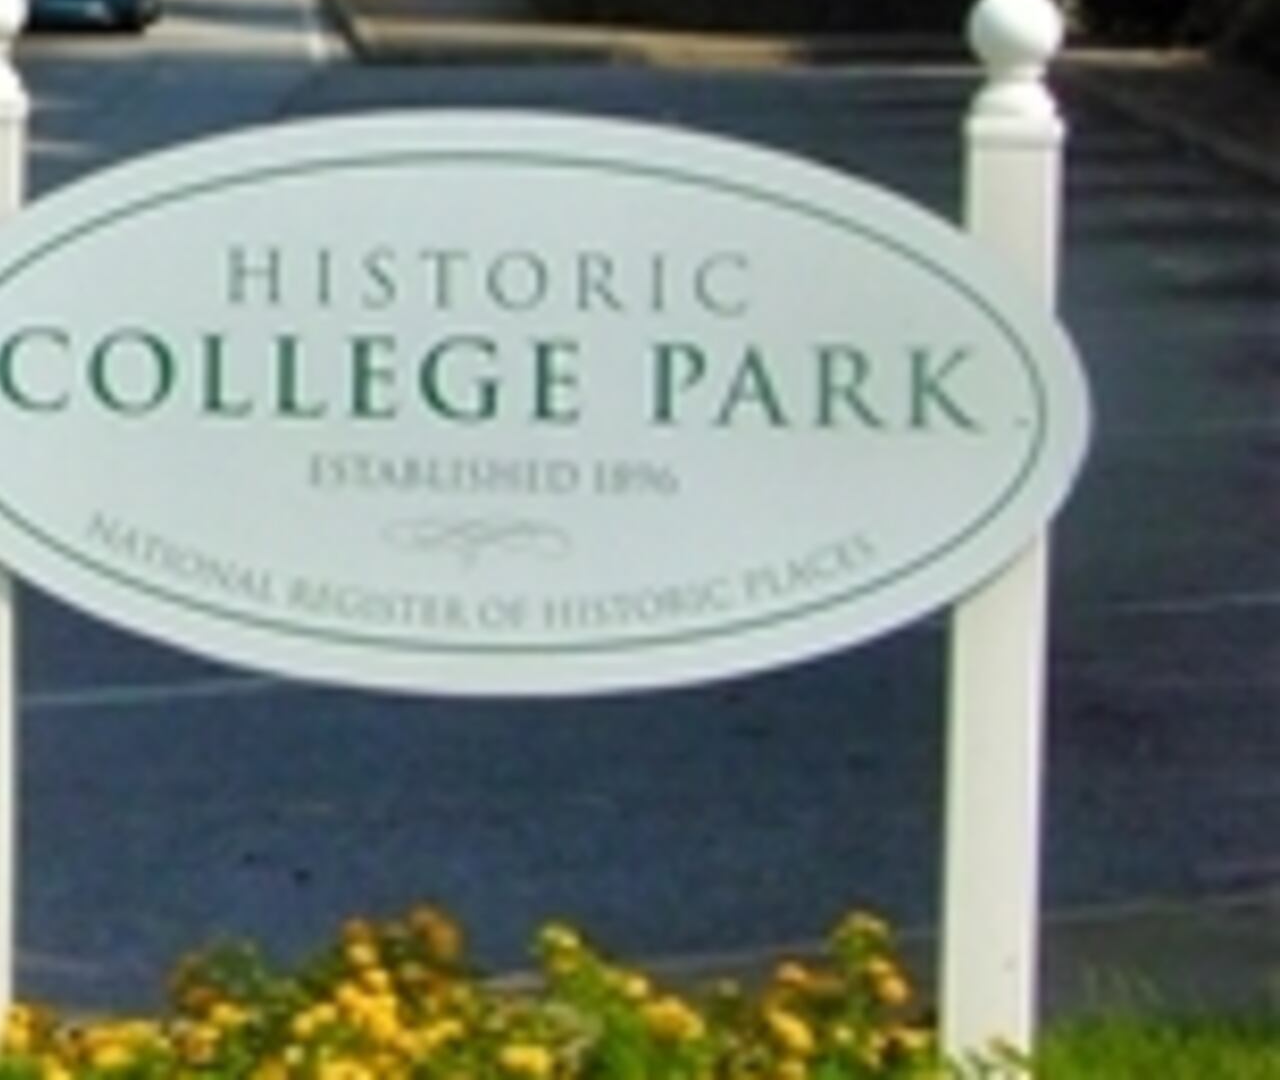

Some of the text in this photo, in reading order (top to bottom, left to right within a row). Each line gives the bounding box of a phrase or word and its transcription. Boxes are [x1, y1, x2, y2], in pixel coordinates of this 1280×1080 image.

[226, 245, 750, 317] HISTORIC
[651, 342, 980, 432] PARK
[307, 452, 580, 495] ESTABLISHED
[88, 512, 877, 629] NATIONAL REGISTER OF HISTORIC PLACES
